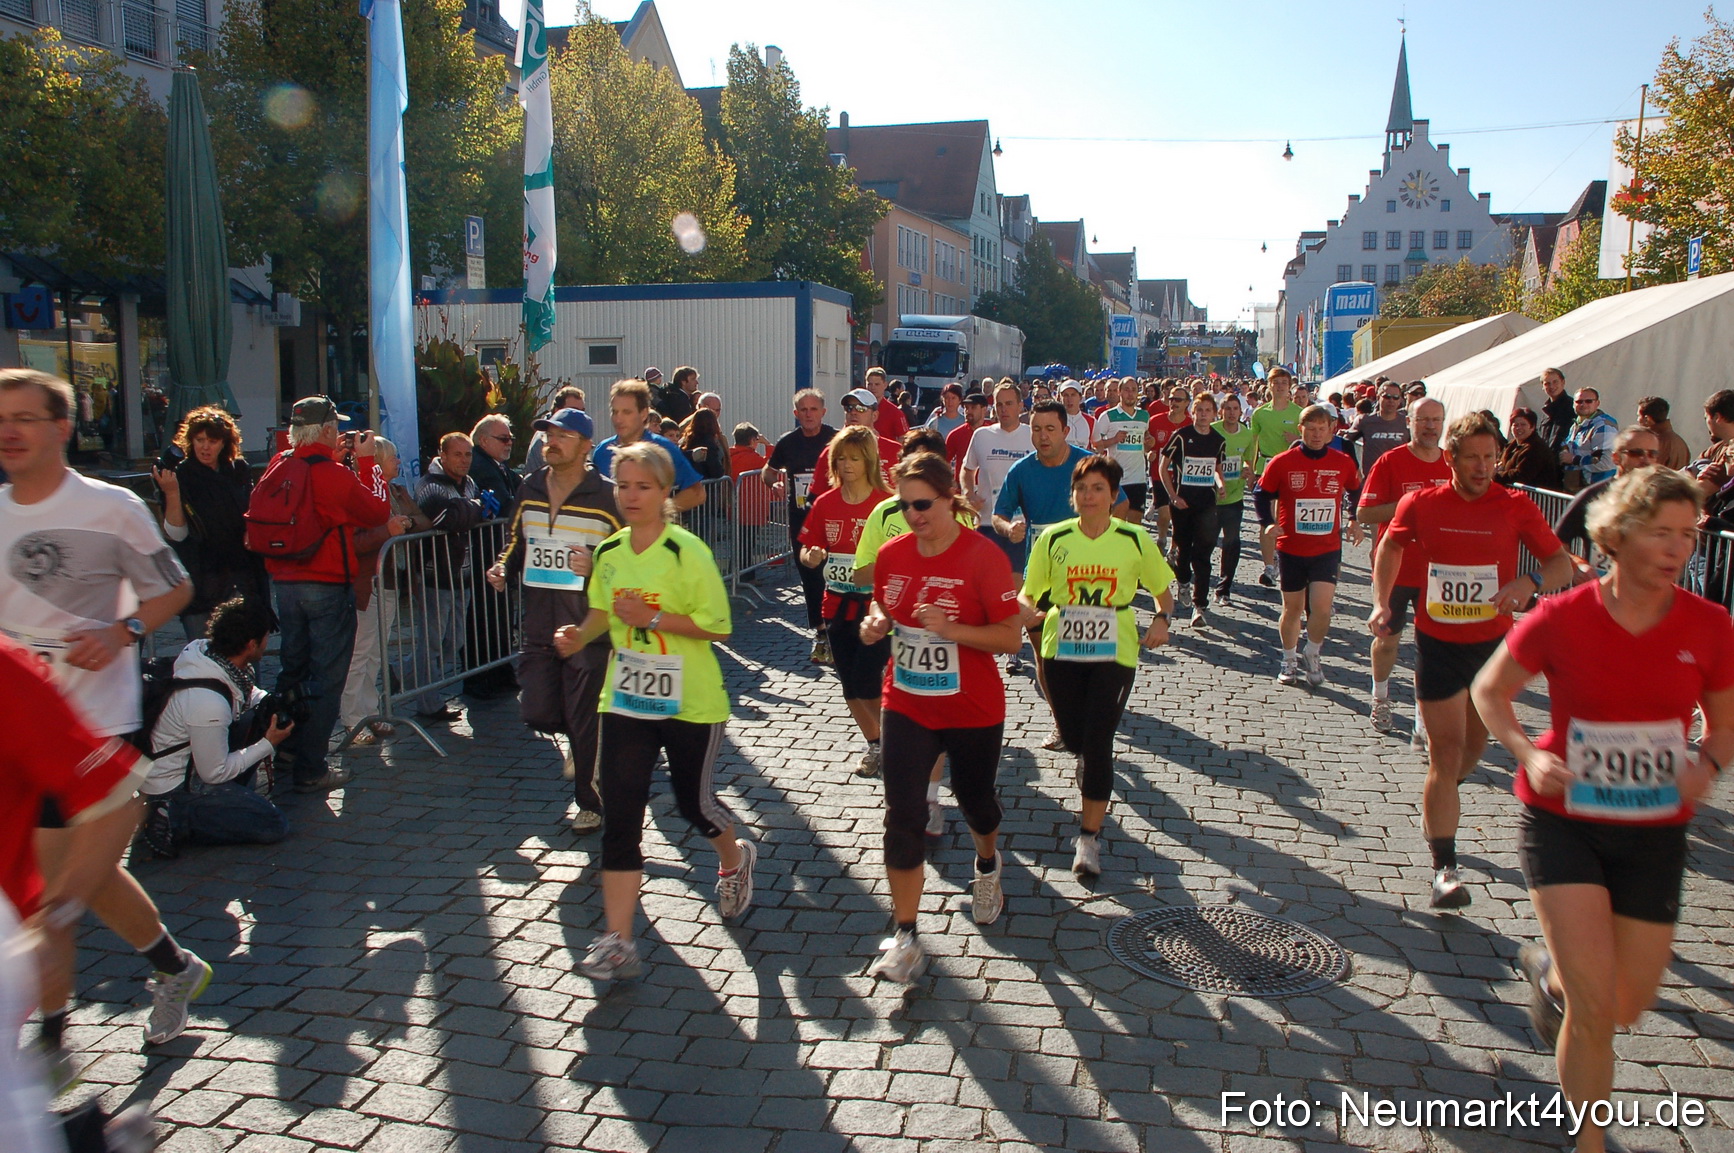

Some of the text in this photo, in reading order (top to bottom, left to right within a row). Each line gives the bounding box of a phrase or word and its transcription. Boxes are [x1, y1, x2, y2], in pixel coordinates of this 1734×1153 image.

[470, 221, 480, 250] P
[1690, 242, 1699, 269] P
[1336, 291, 1372, 310] maxi
[1187, 464, 1212, 476] 2745
[1300, 508, 1332, 521] 2177
[1302, 522, 1330, 532] Michael
[1067, 565, 1119, 576] Müller
[1441, 581, 1484, 603] 802
[1442, 604, 1482, 616] Stefan
[1062, 620, 1111, 641] 2932
[896, 641, 949, 671] 2749
[1074, 643, 1096, 655] Rita
[619, 666, 673, 697] 2120
[624, 695, 667, 712] Monika
[1581, 746, 1674, 785] 2969
